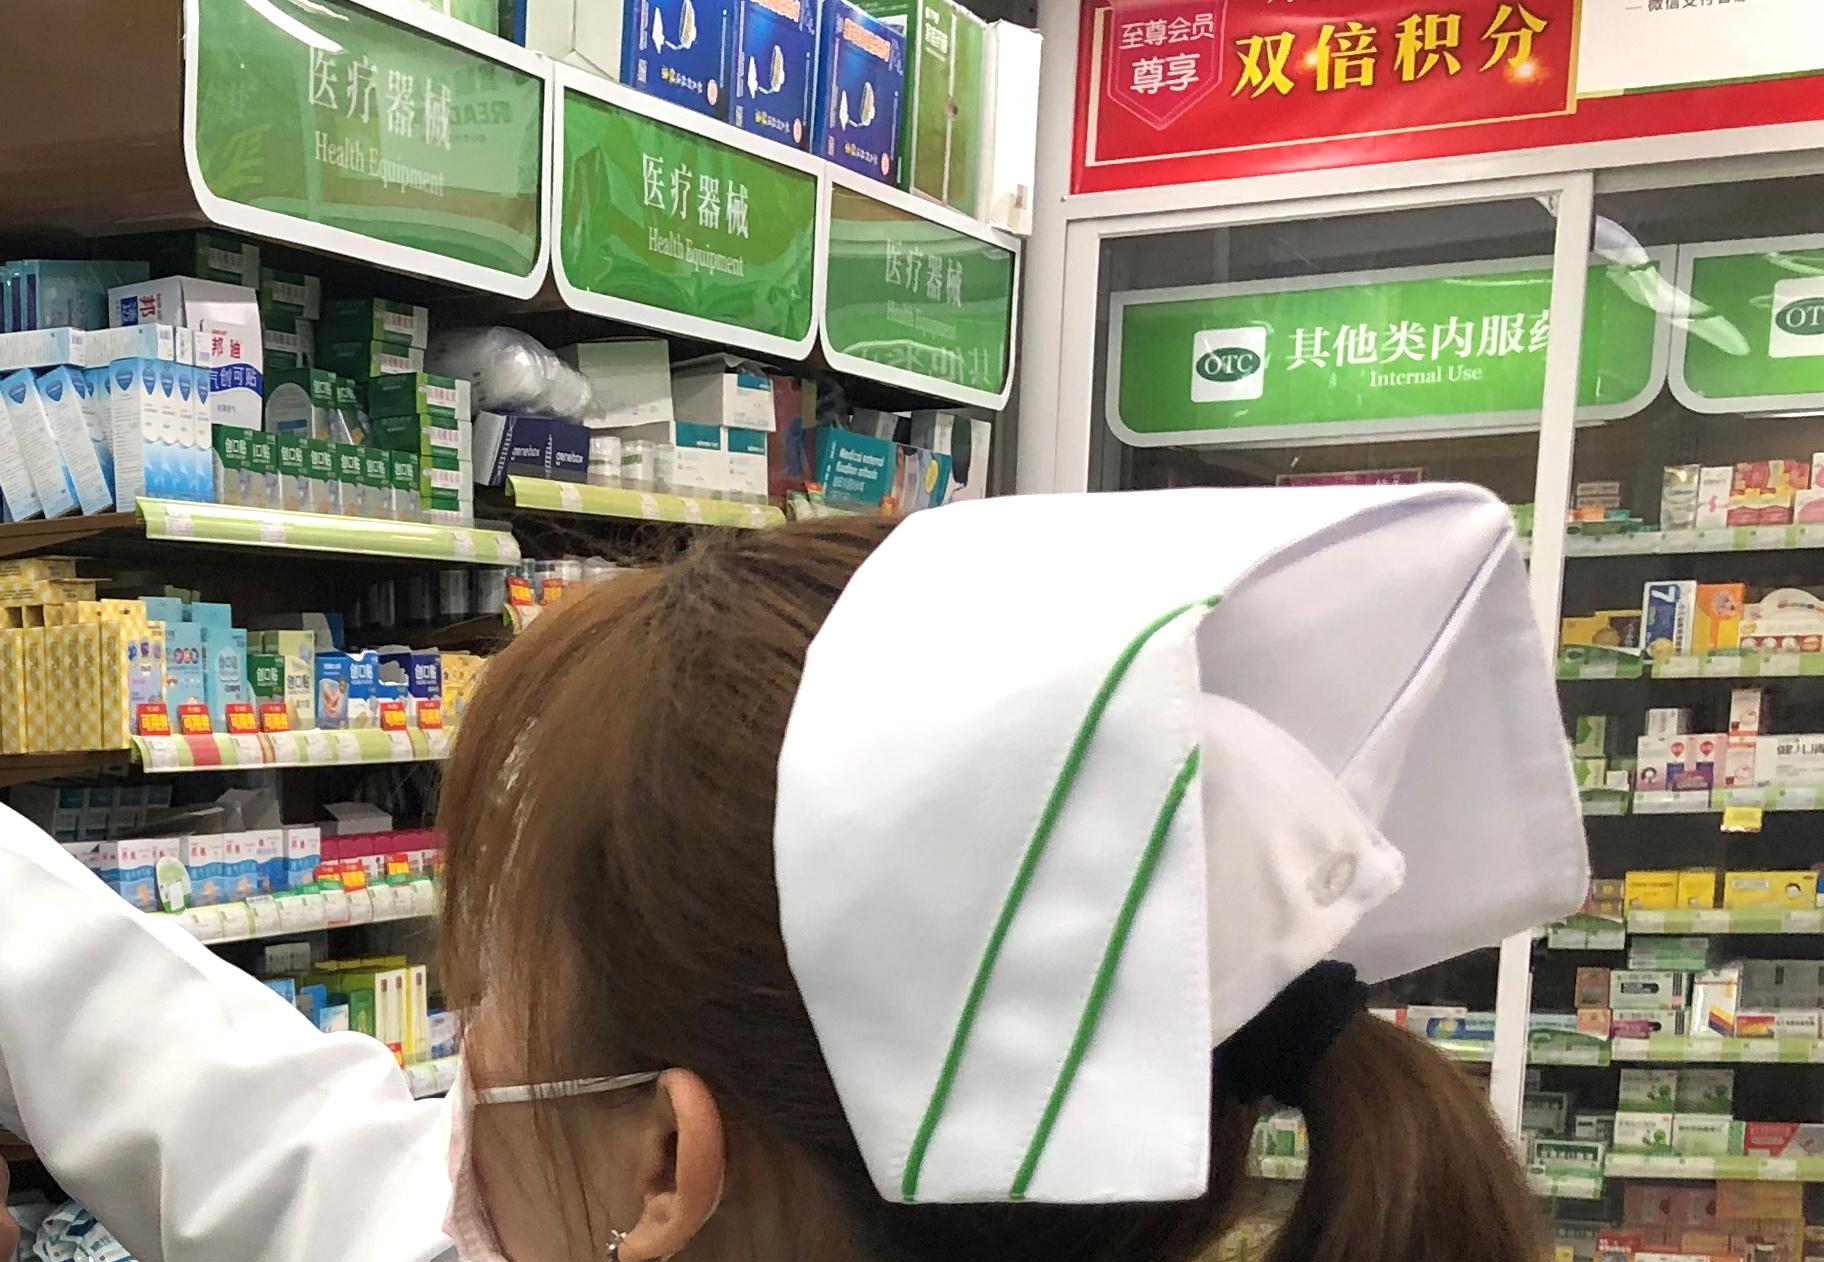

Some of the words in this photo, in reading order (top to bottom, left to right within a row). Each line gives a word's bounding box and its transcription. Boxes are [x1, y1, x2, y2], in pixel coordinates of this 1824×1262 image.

[1119, 13, 1215, 50] 至尊会员
[1230, 3, 1548, 98] 双倍积分
[1130, 52, 1200, 94] 尊享
[308, 46, 452, 151] 医疗器械
[315, 131, 365, 175] Health
[642, 152, 749, 239] 医疗器械
[648, 226, 685, 260] Health
[886, 239, 963, 308] 医疗器械
[1203, 352, 1254, 377] OTC
[1369, 366, 1442, 388] Internal
[1448, 364, 1483, 382] Use
